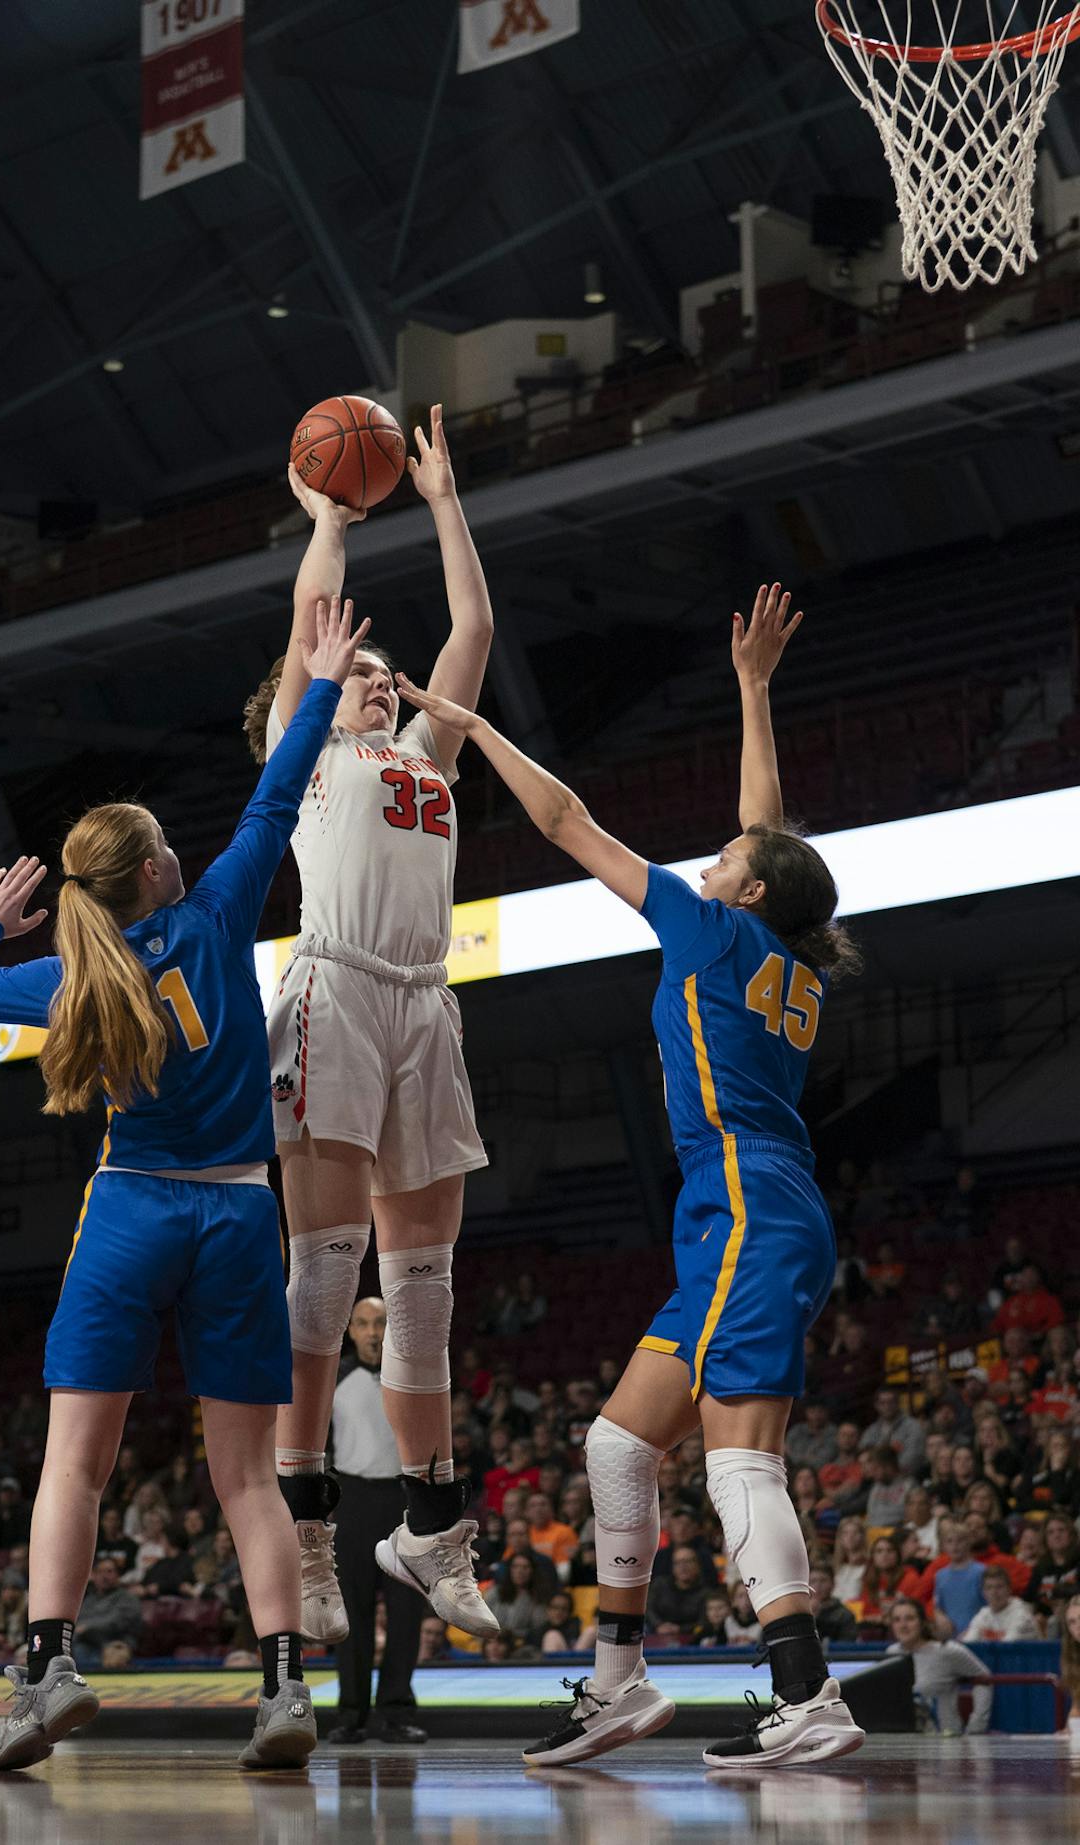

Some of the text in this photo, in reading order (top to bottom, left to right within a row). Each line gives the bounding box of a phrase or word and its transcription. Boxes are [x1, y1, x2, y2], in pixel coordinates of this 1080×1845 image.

[380, 767, 451, 841] 32
[155, 966, 210, 1053] 1
[745, 951, 823, 1052] 45
